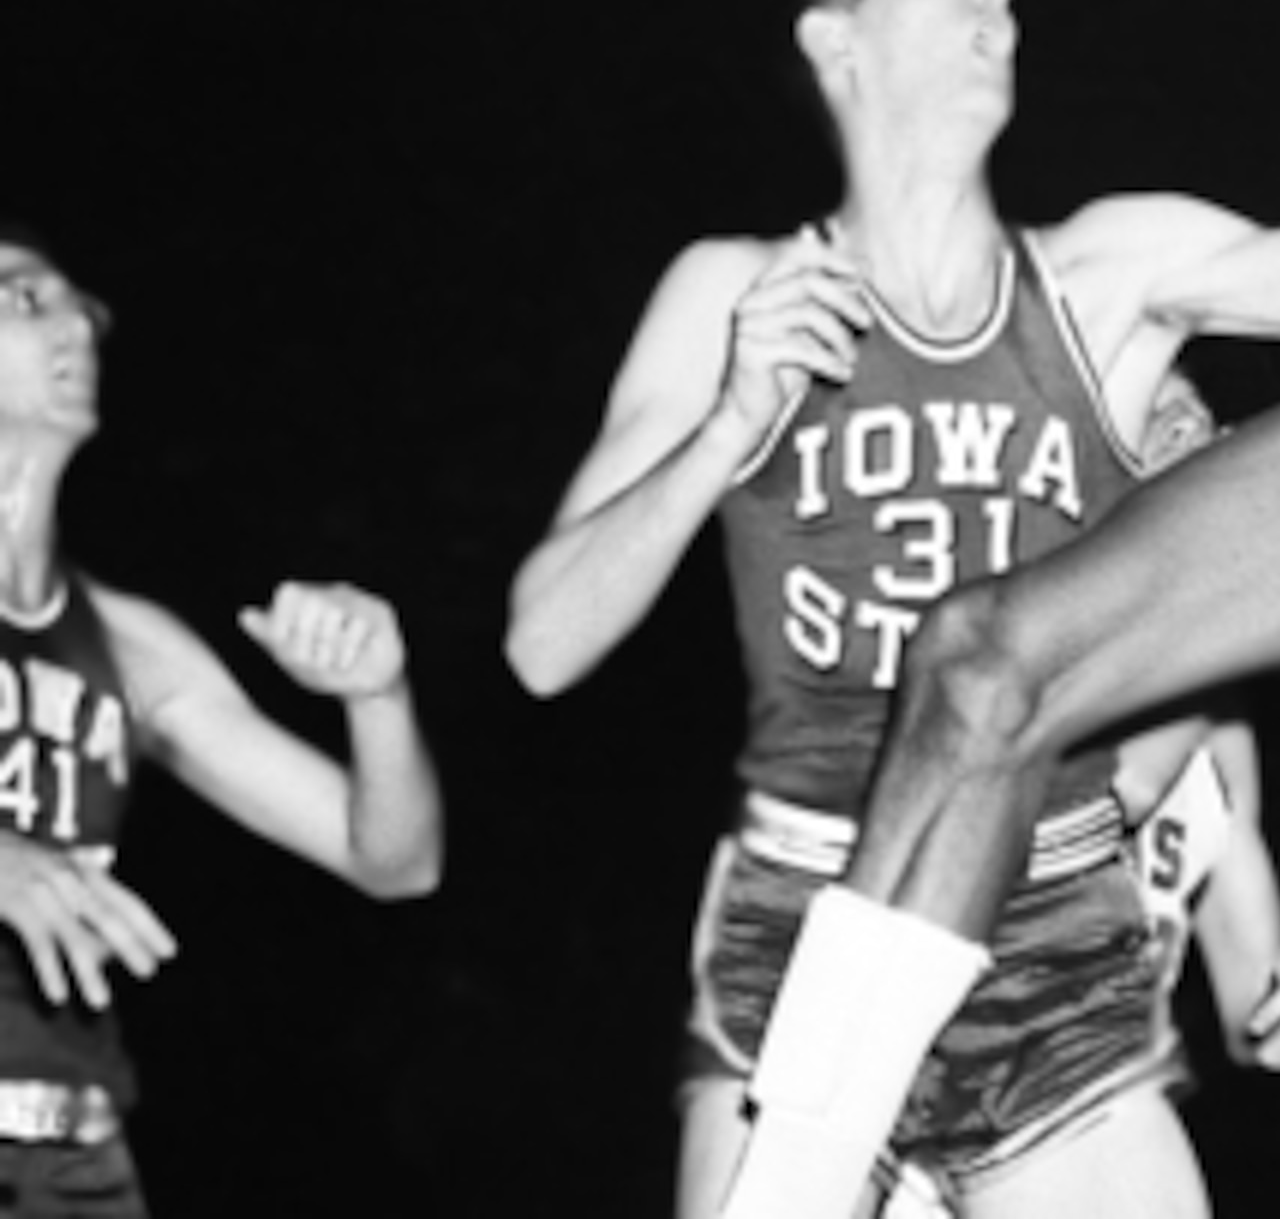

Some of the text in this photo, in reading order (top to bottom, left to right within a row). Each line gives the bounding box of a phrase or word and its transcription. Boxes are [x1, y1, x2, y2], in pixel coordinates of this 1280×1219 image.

[794, 401, 1082, 520] IOWA
[873, 497, 1014, 599] 31
[0, 735, 80, 841] 41
